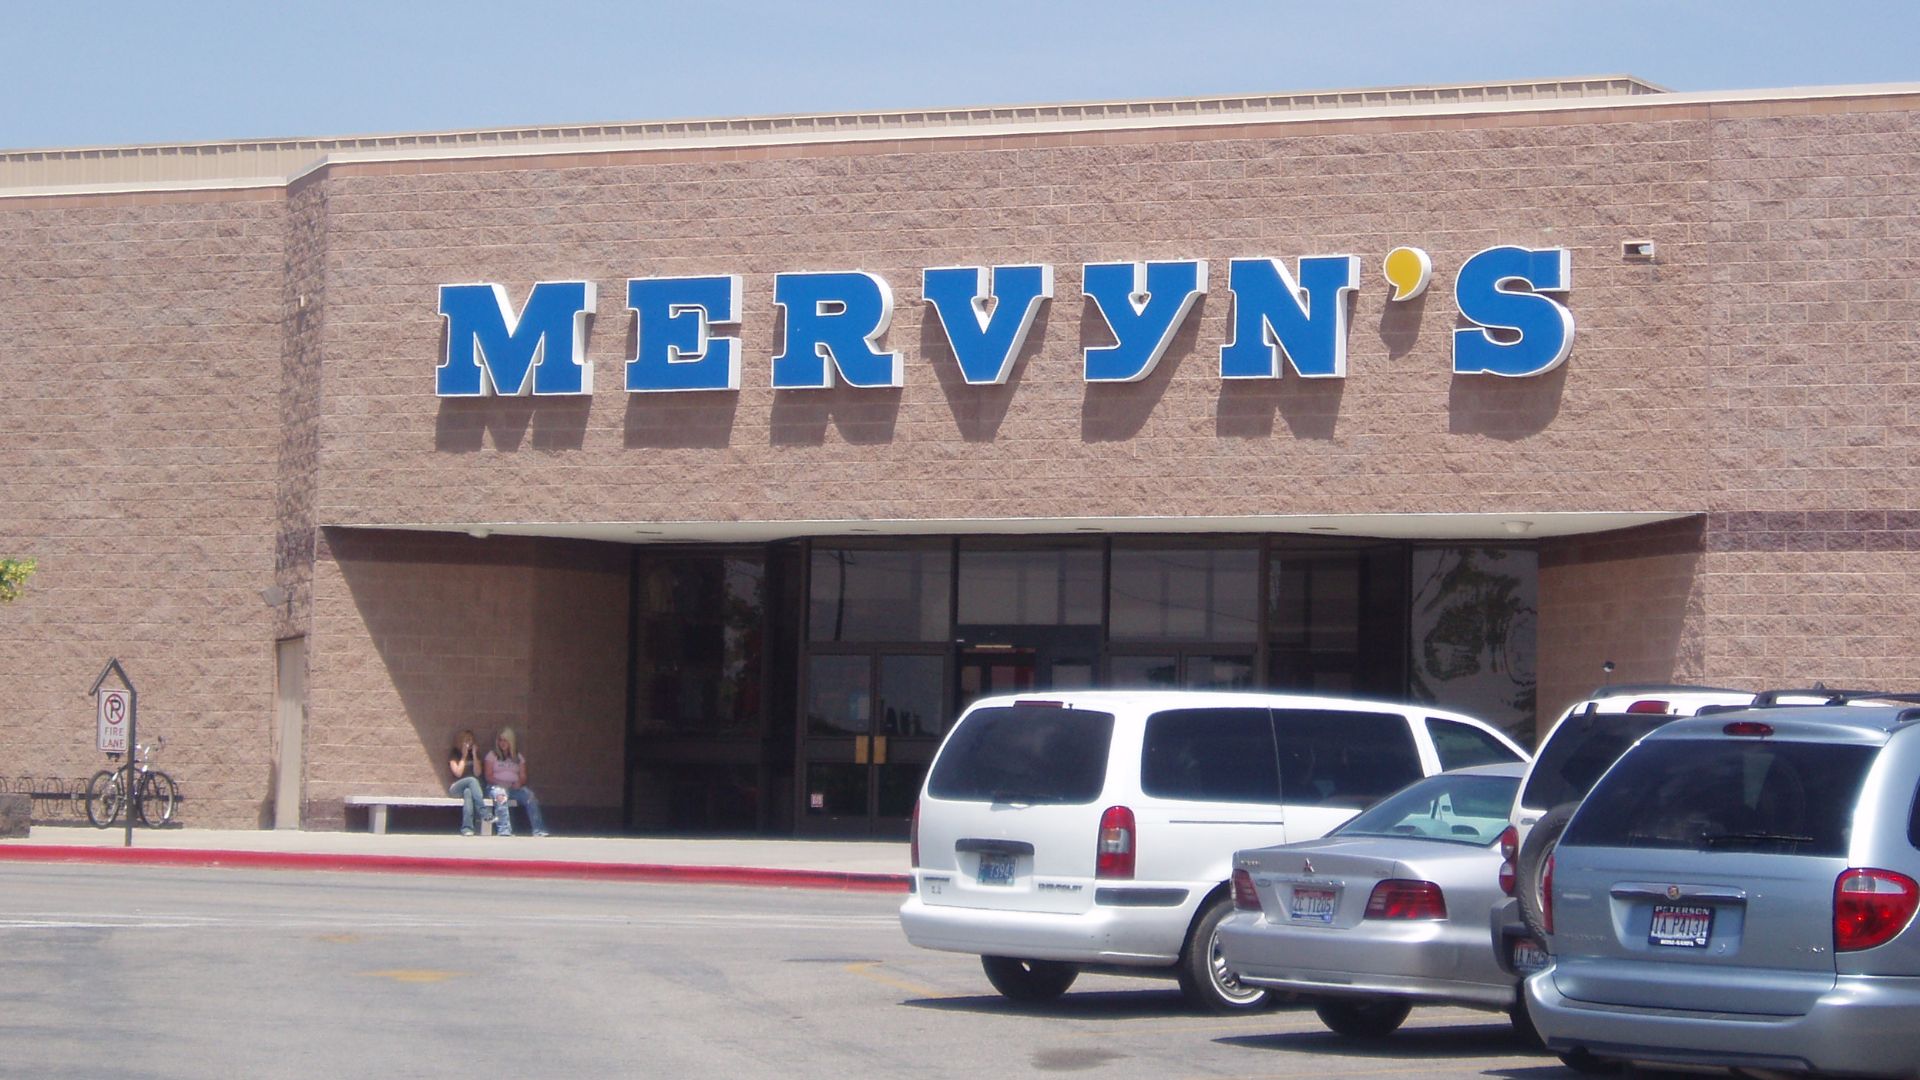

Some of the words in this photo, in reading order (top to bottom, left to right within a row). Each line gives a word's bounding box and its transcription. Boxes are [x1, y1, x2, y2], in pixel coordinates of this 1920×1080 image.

[436, 245, 1575, 397] MERVYN'S
[104, 726, 124, 737] FIRE
[102, 739, 125, 749] LANE
